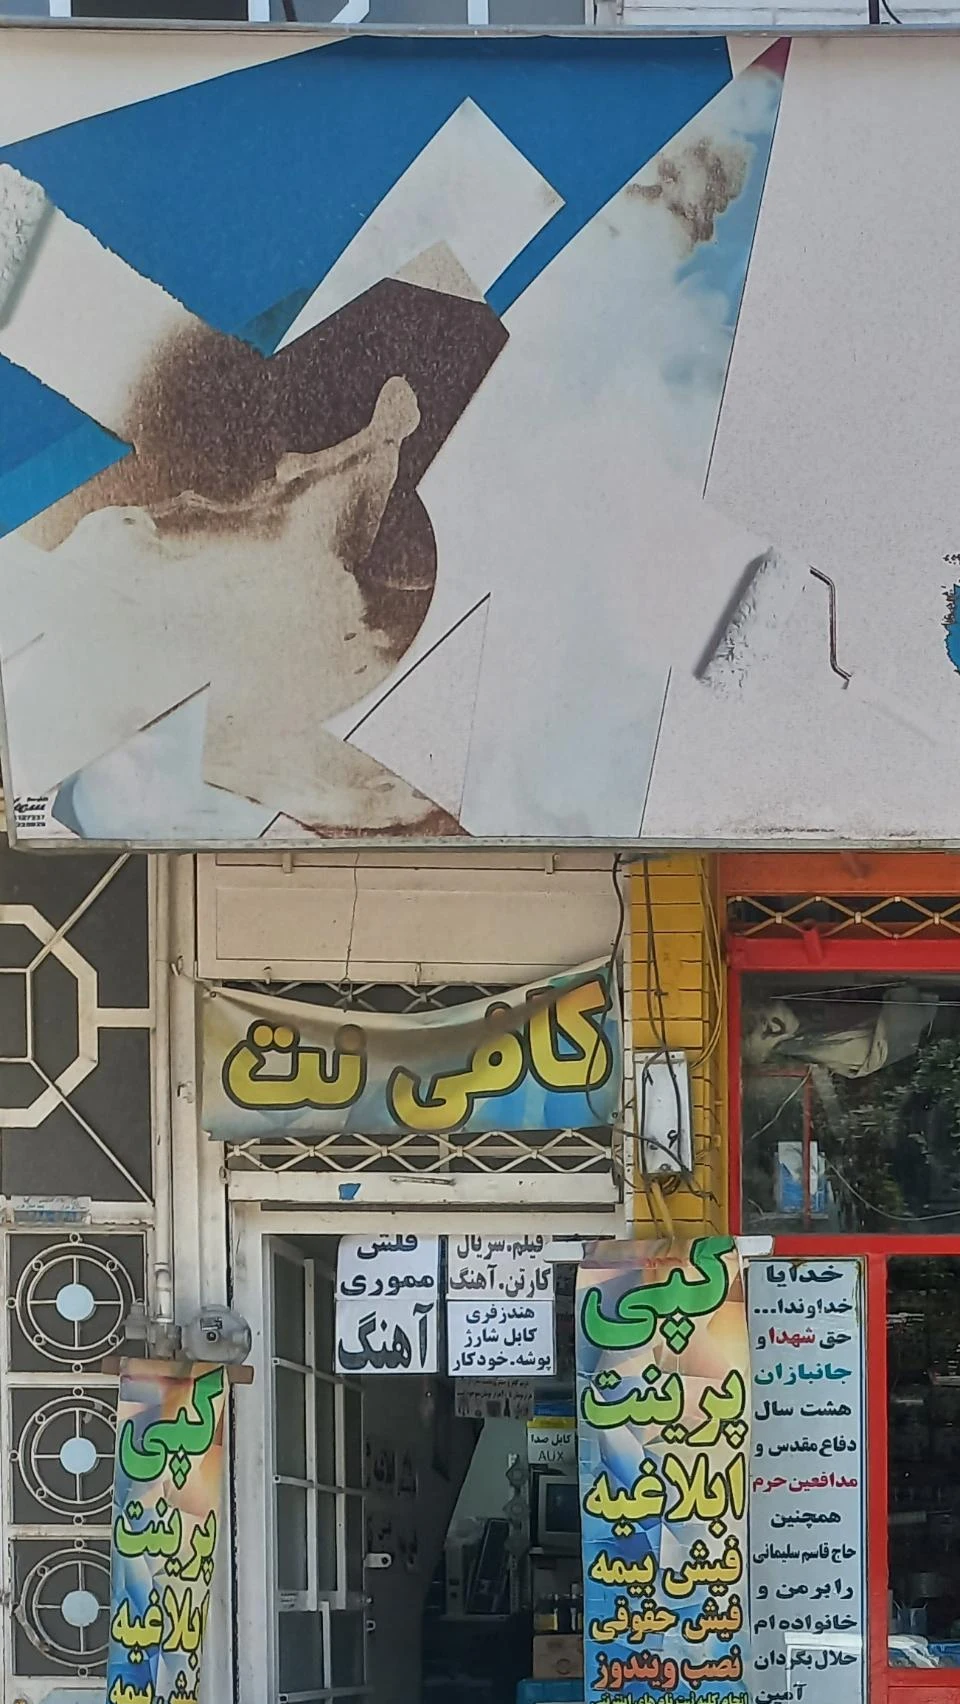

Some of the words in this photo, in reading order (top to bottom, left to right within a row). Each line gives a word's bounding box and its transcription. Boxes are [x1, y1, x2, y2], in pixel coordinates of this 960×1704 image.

[222, 1018, 368, 1112] نت
[386, 978, 615, 1132] کافی
[340, 1272, 435, 1298] مموری
[766, 1264, 844, 1285] خدایا
[581, 1235, 735, 1354] کپی
[466, 1304, 536, 1325] هندزفری
[337, 1302, 435, 1370] آهنگ
[464, 1328, 499, 1349] شارژ
[503, 1327, 538, 1348] کابل
[756, 1336, 766, 1350] و
[768, 1327, 816, 1347] شهدا
[819, 1329, 852, 1349] حق
[753, 1364, 853, 1386] جانبازان
[581, 1364, 749, 1449] پرینت
[754, 1400, 794, 1421] سال
[799, 1399, 852, 1418] هشت
[119, 1365, 224, 1490] کپی
[531, 1433, 549, 1445] صدا
[551, 1434, 572, 1447] کابل
[767, 1439, 818, 1458] مقدس
[818, 1436, 857, 1457] دفاع
[538, 1450, 564, 1462] AUX
[755, 1443, 764, 1457] و
[752, 1475, 788, 1494] حرم
[788, 1470, 859, 1492] مدافعین
[583, 1452, 746, 1538] ابلاغیه
[770, 1510, 842, 1529] همچنین
[114, 1496, 217, 1586] پرینت
[752, 1543, 800, 1564] سلیمانی
[801, 1542, 830, 1563] قاسم
[830, 1544, 857, 1564] حاج
[589, 1550, 657, 1597] بیمه
[663, 1536, 743, 1599] فیش
[756, 1586, 769, 1600] و
[775, 1583, 808, 1600] من
[808, 1583, 834, 1600] بر
[834, 1578, 854, 1600] را
[590, 1595, 679, 1644] حقوقی
[684, 1594, 743, 1645] فیش
[753, 1614, 776, 1635] ام
[778, 1612, 859, 1635] خانواده
[682, 1645, 743, 1687] نصب
[753, 1648, 814, 1671] بگردان
[814, 1646, 858, 1668] حلال
[593, 1648, 679, 1691] ویندوز
